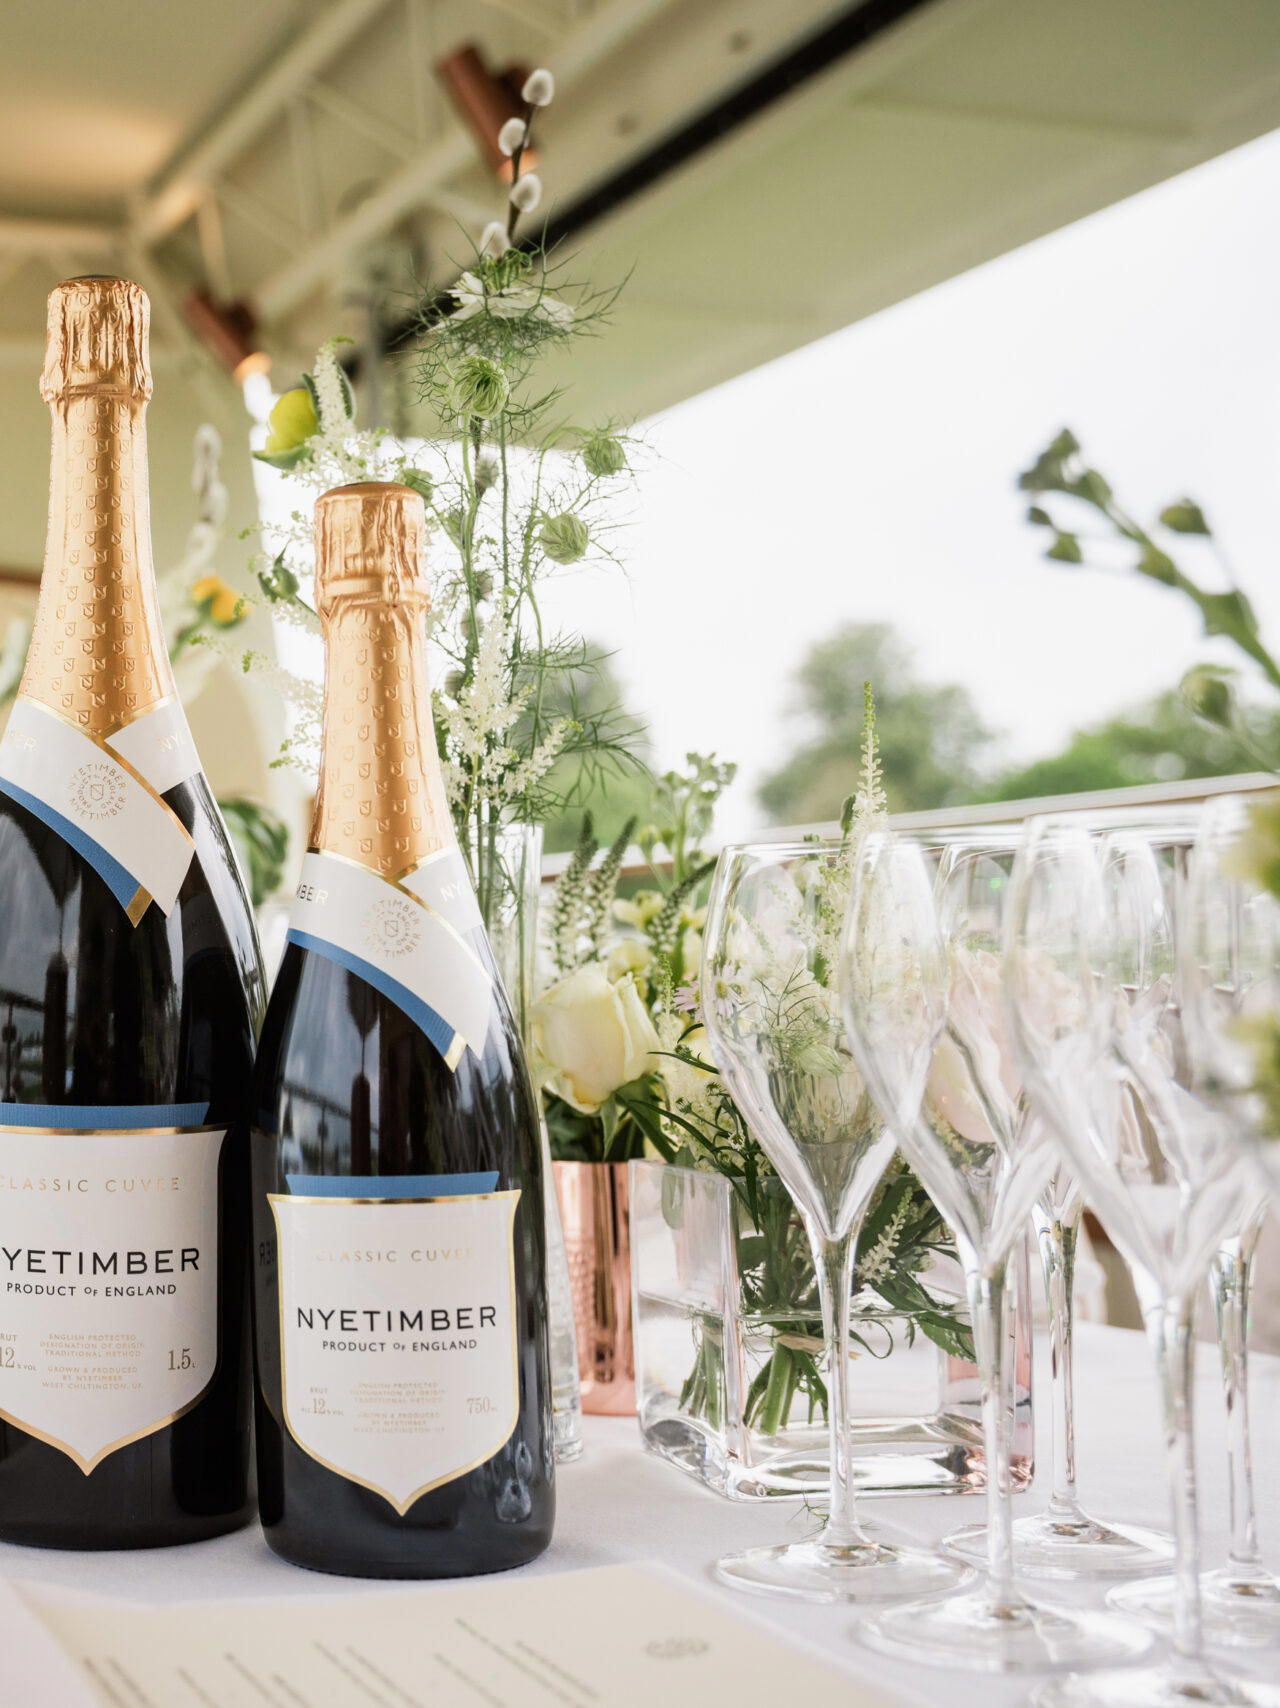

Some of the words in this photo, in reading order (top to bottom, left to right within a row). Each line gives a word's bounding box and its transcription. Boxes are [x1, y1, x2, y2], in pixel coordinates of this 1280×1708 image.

[7, 1282, 77, 1297] PRODUCT
[105, 1284, 177, 1297] ENGLAND
[297, 1305, 497, 1332] NYETIMBER
[322, 1340, 385, 1352] PRODUCT
[412, 1339, 478, 1352] ENGLAND
[312, 1398, 326, 1415] 12
